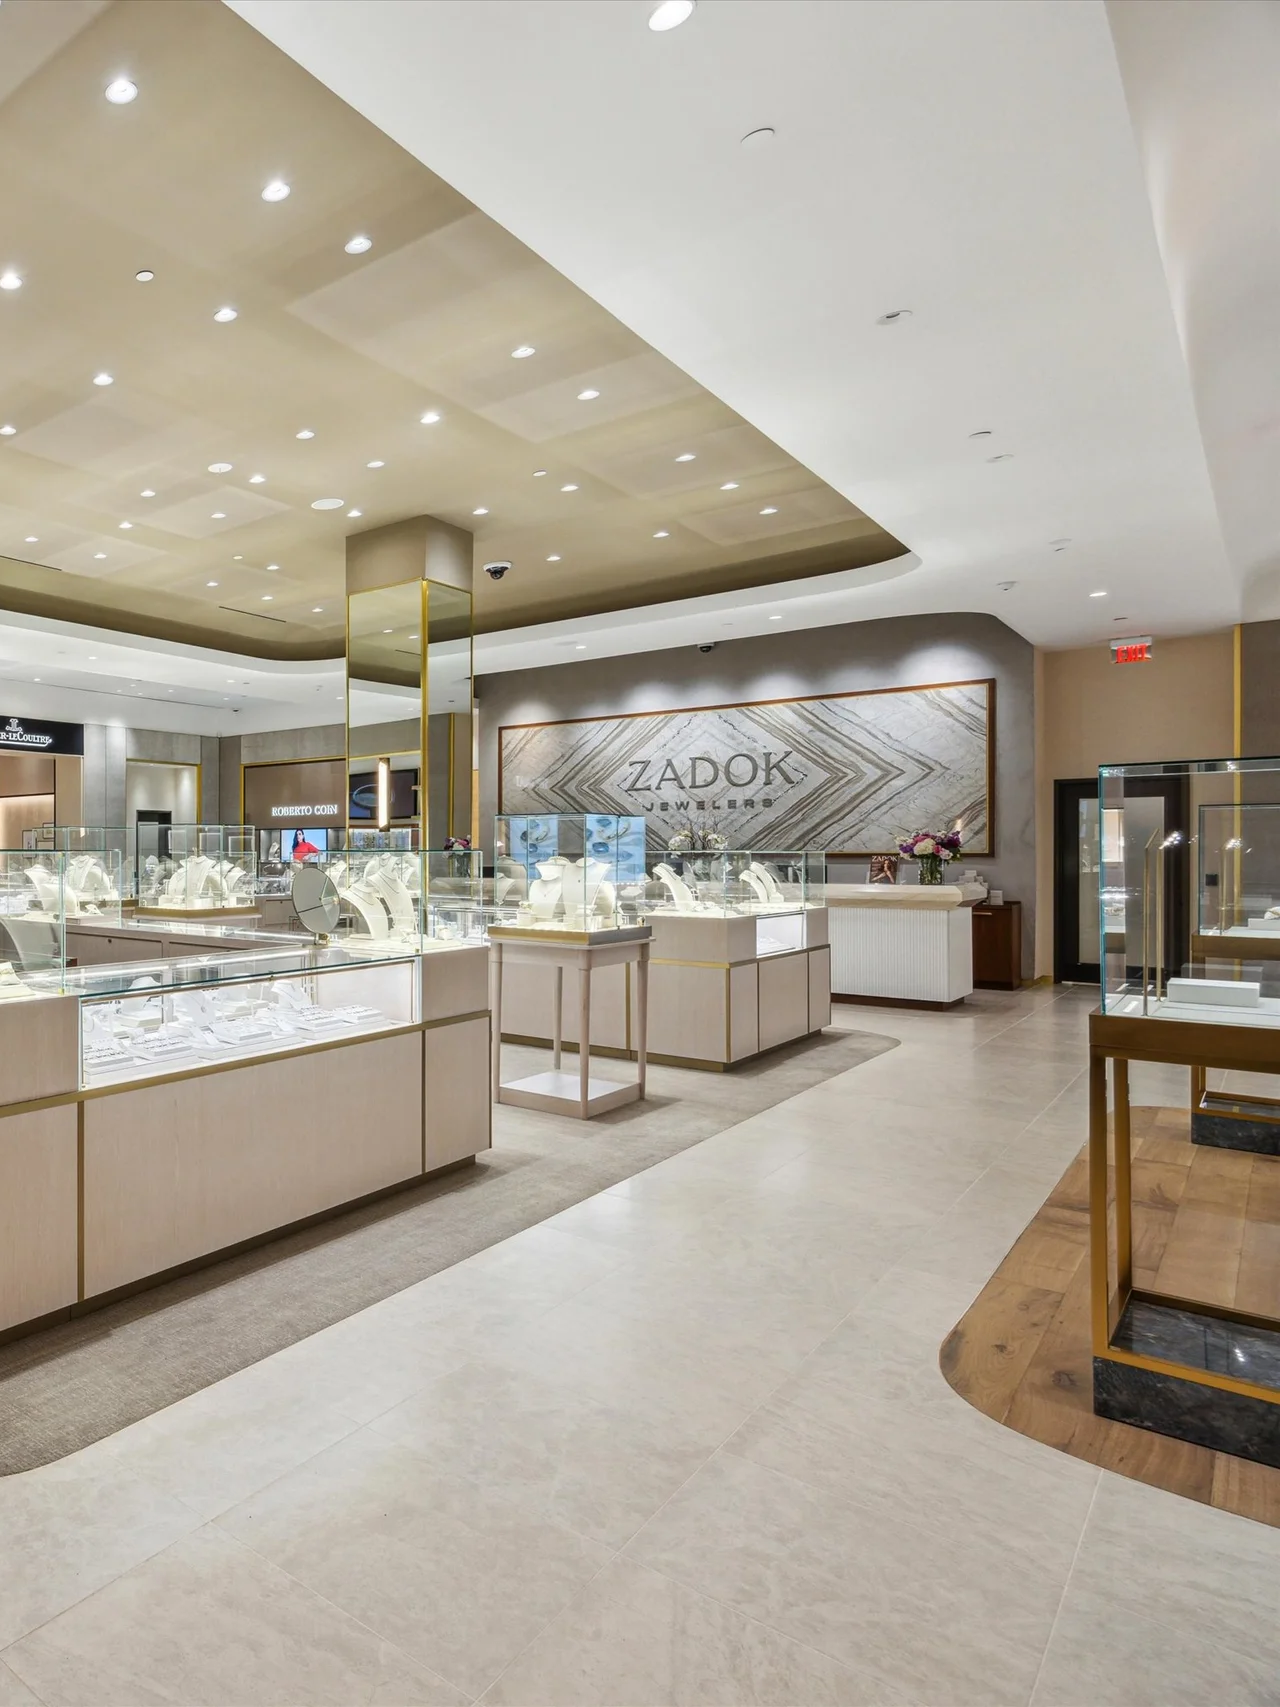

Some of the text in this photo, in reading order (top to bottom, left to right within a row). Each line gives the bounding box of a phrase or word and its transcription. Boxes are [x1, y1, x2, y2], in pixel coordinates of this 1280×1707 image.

[1116, 644, 1149, 663] EXIT
[626, 750, 795, 792] ZADOK
[271, 804, 338, 817] ROBERTO COIN
[644, 798, 773, 812] JEWELERS
